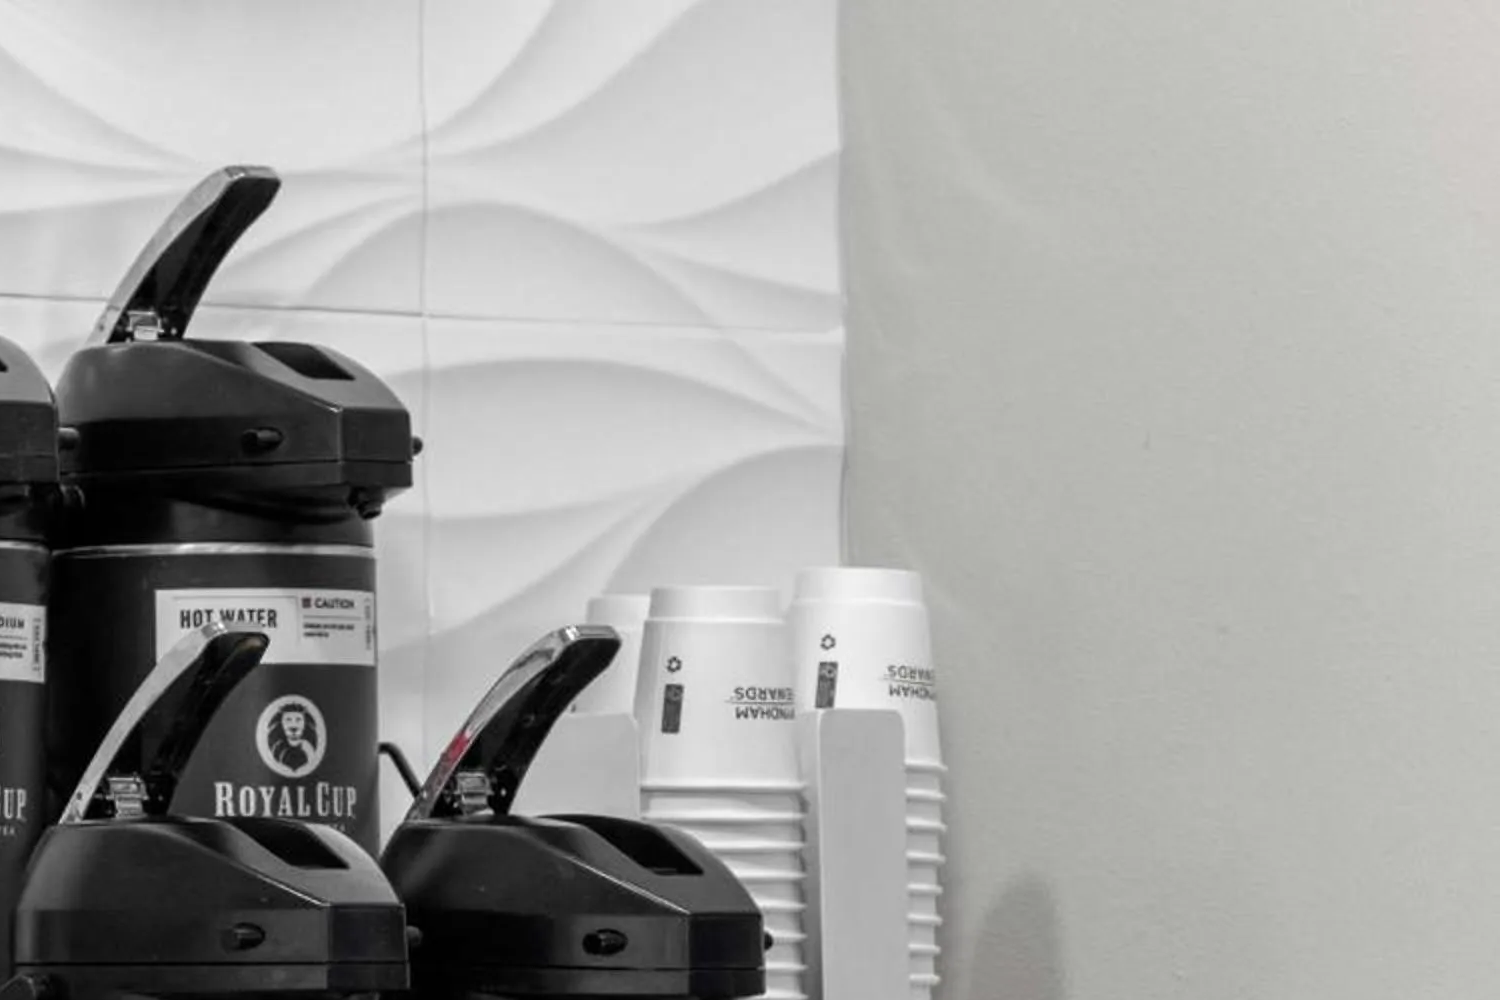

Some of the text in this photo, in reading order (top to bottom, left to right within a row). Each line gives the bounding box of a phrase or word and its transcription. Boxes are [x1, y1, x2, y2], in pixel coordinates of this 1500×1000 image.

[315, 597, 355, 609] CAUTION
[180, 609, 278, 628] HOT WATER
[214, 781, 358, 819] ROYAL CUP
